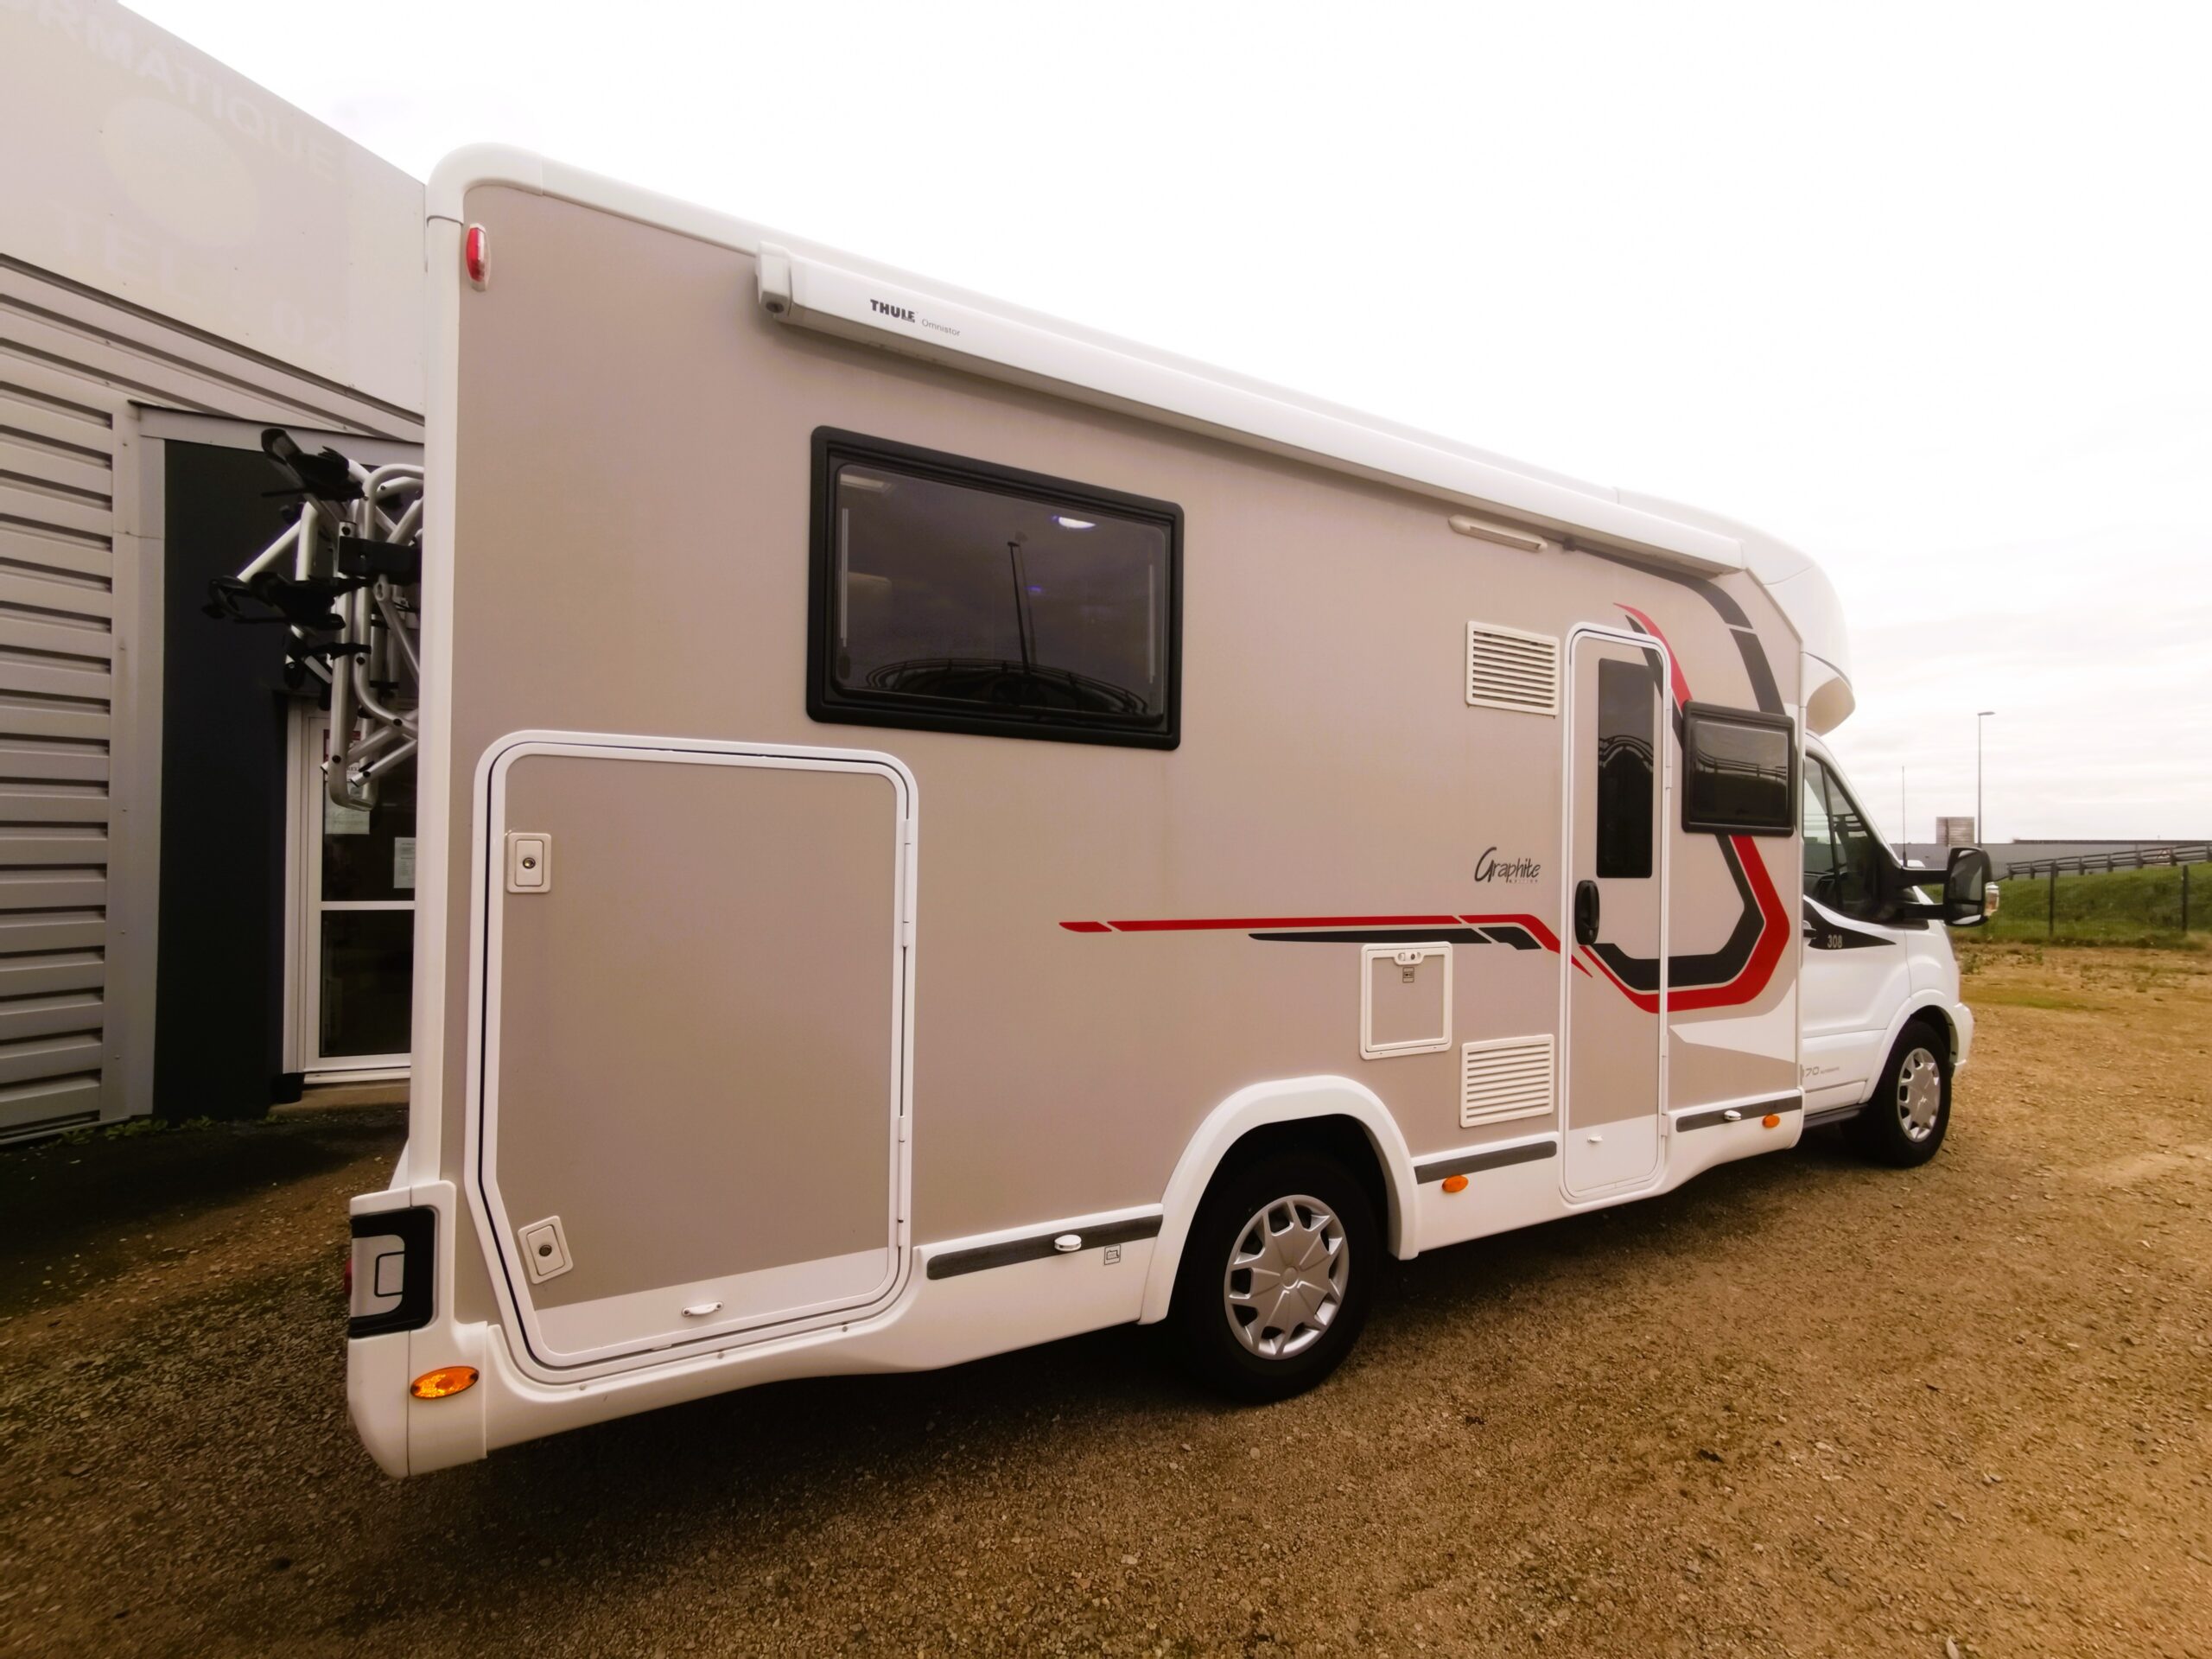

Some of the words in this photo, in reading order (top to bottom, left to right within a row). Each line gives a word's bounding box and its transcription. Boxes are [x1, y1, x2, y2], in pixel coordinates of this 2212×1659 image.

[0, 0, 340, 184] RMATIQUE
[870, 299, 915, 323] THULE
[921, 318, 961, 337] Omnistor
[1474, 846, 1541, 883] Graphite
[1827, 934, 1843, 949] 308
